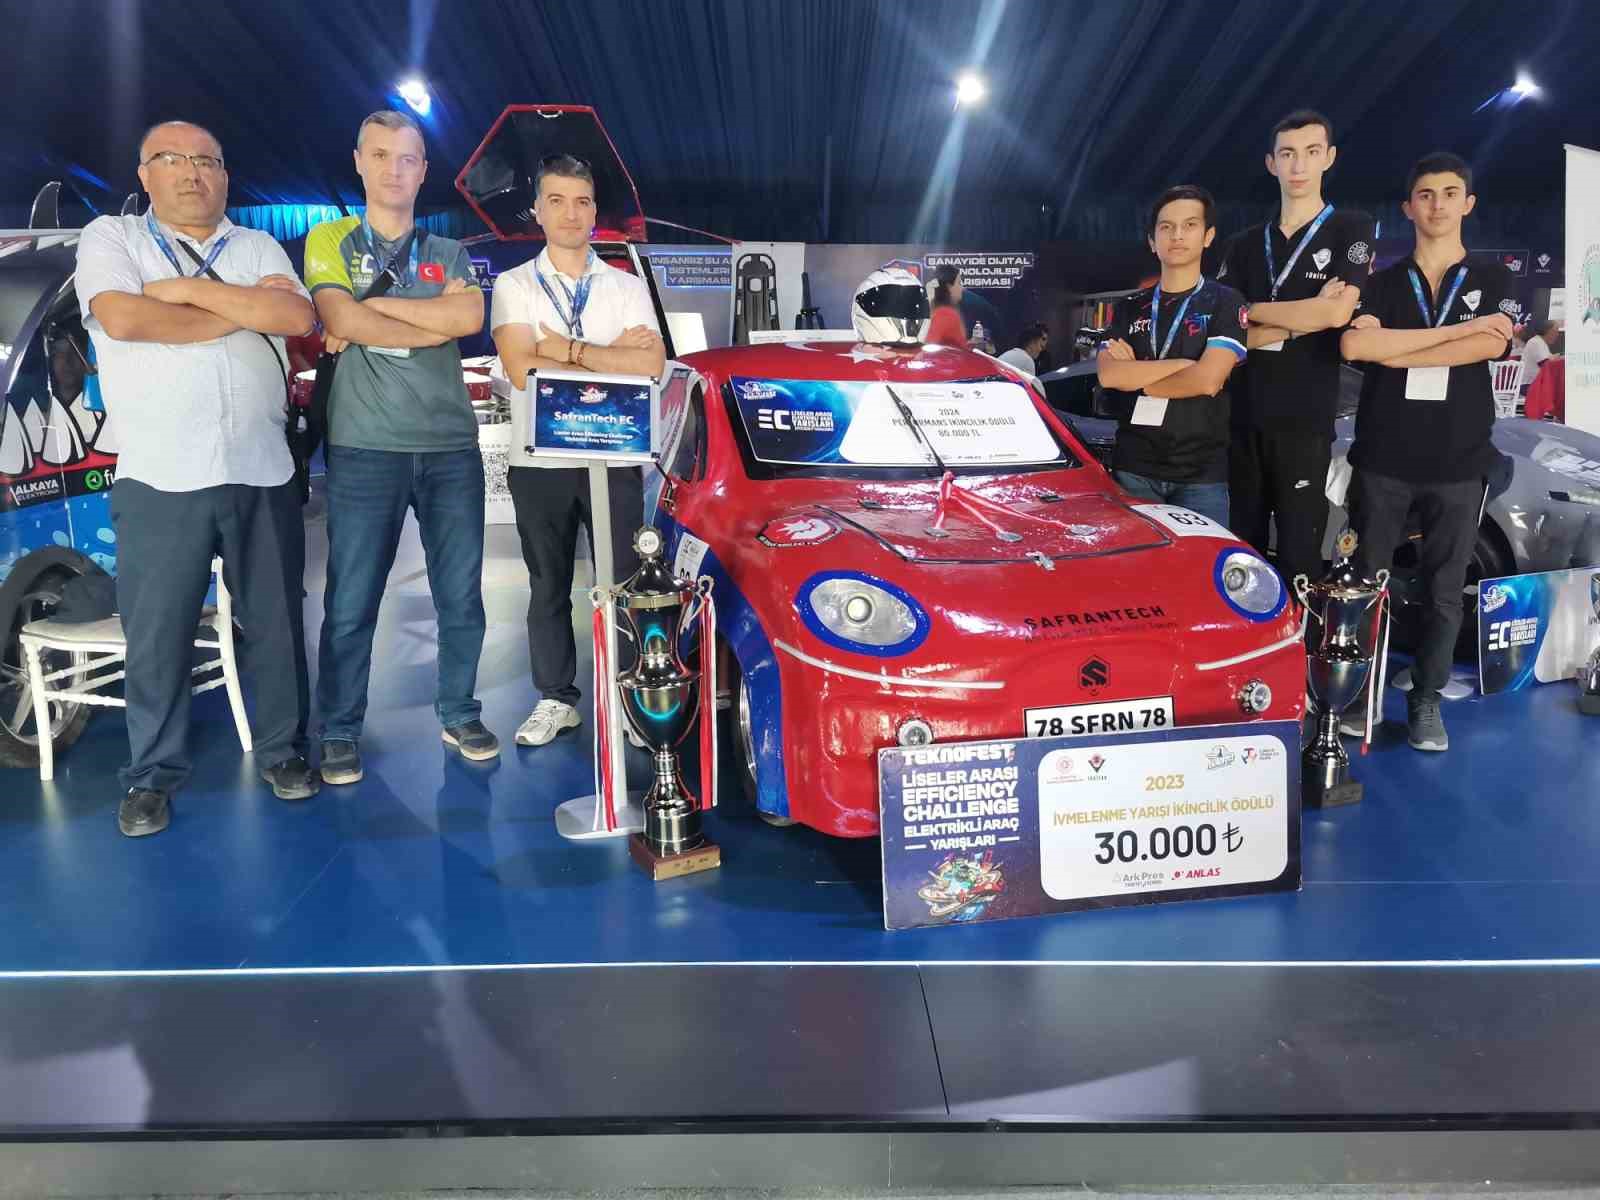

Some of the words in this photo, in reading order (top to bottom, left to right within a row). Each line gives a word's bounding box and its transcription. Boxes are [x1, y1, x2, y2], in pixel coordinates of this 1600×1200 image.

[554, 410, 617, 425] SafranTech
[619, 416, 635, 426] EC
[892, 418, 948, 426] PERRMANS
[15, 479, 60, 495] ALKAYA
[1168, 512, 1208, 525] 63
[1024, 605, 1166, 630] SAFRANTECH
[1034, 717, 1064, 737] 78
[1071, 711, 1134, 735] SFRN
[1140, 707, 1167, 728] 78
[901, 743, 1017, 766] TEKNOFEST
[902, 770, 968, 788] LİSELER
[969, 766, 1018, 783] ARASI
[1145, 774, 1185, 791] 2023
[902, 781, 1018, 806] EFFICIENCY
[903, 798, 1019, 822] CHALLENGE
[1053, 807, 1127, 826] İVMELENME
[1129, 803, 1171, 821] YARIŞI
[1173, 799, 1229, 818] İKİNCİLİK
[1231, 795, 1274, 811] ÖDÜLÜ
[904, 817, 982, 838] ELEKTRİKLİ
[983, 817, 1019, 831] ARAÇ
[930, 835, 996, 850] YARIŞLARI
[1094, 823, 1217, 865] 30.000
